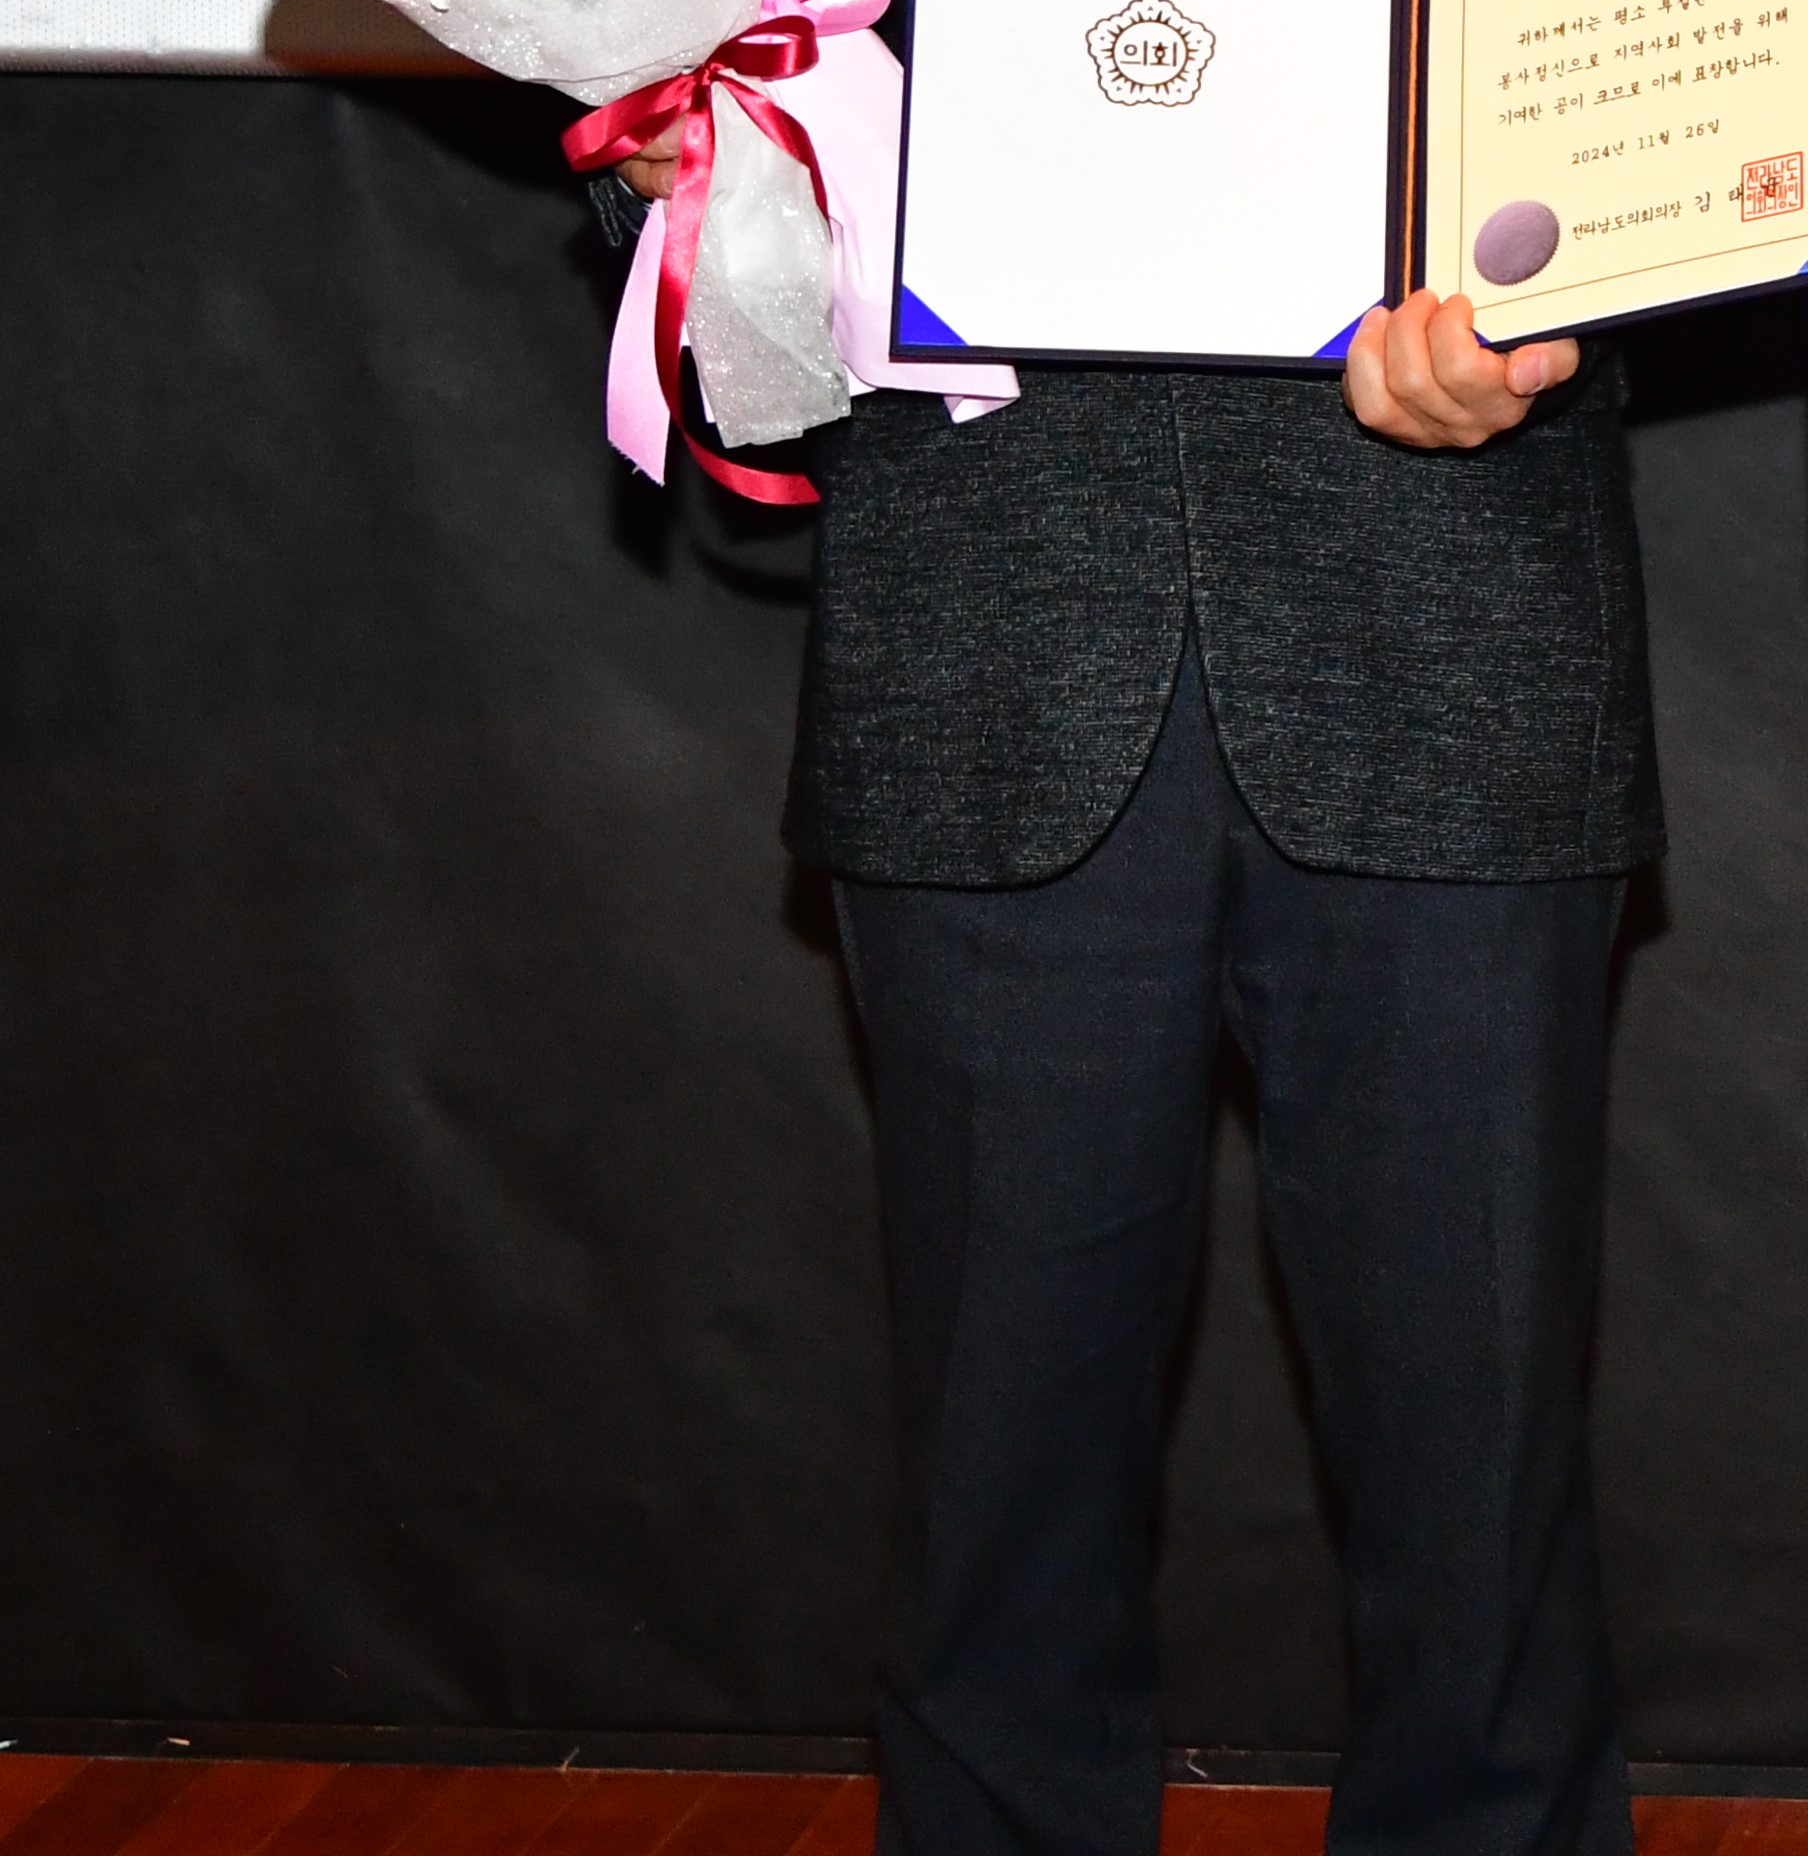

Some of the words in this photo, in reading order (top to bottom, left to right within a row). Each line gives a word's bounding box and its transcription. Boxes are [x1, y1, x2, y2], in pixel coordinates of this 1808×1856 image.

[1613, 5, 1645, 25] 평소
[1119, 40, 1179, 68] 의회
[1497, 52, 1601, 92] 봉사정신으로
[1613, 32, 1680, 61] 지역사회
[1692, 17, 1743, 44] 발전을
[1498, 102, 1542, 125] 기여한
[1553, 92, 1583, 115] 공이
[1593, 80, 1641, 105] 크므로
[1651, 69, 1681, 90] 이에
[1692, 48, 1779, 82] 표창합니다.
[1571, 140, 1624, 165] 2024년
[1638, 129, 1669, 150] 11월
[1685, 118, 1719, 138] 26일
[1694, 190, 1710, 213] 김
